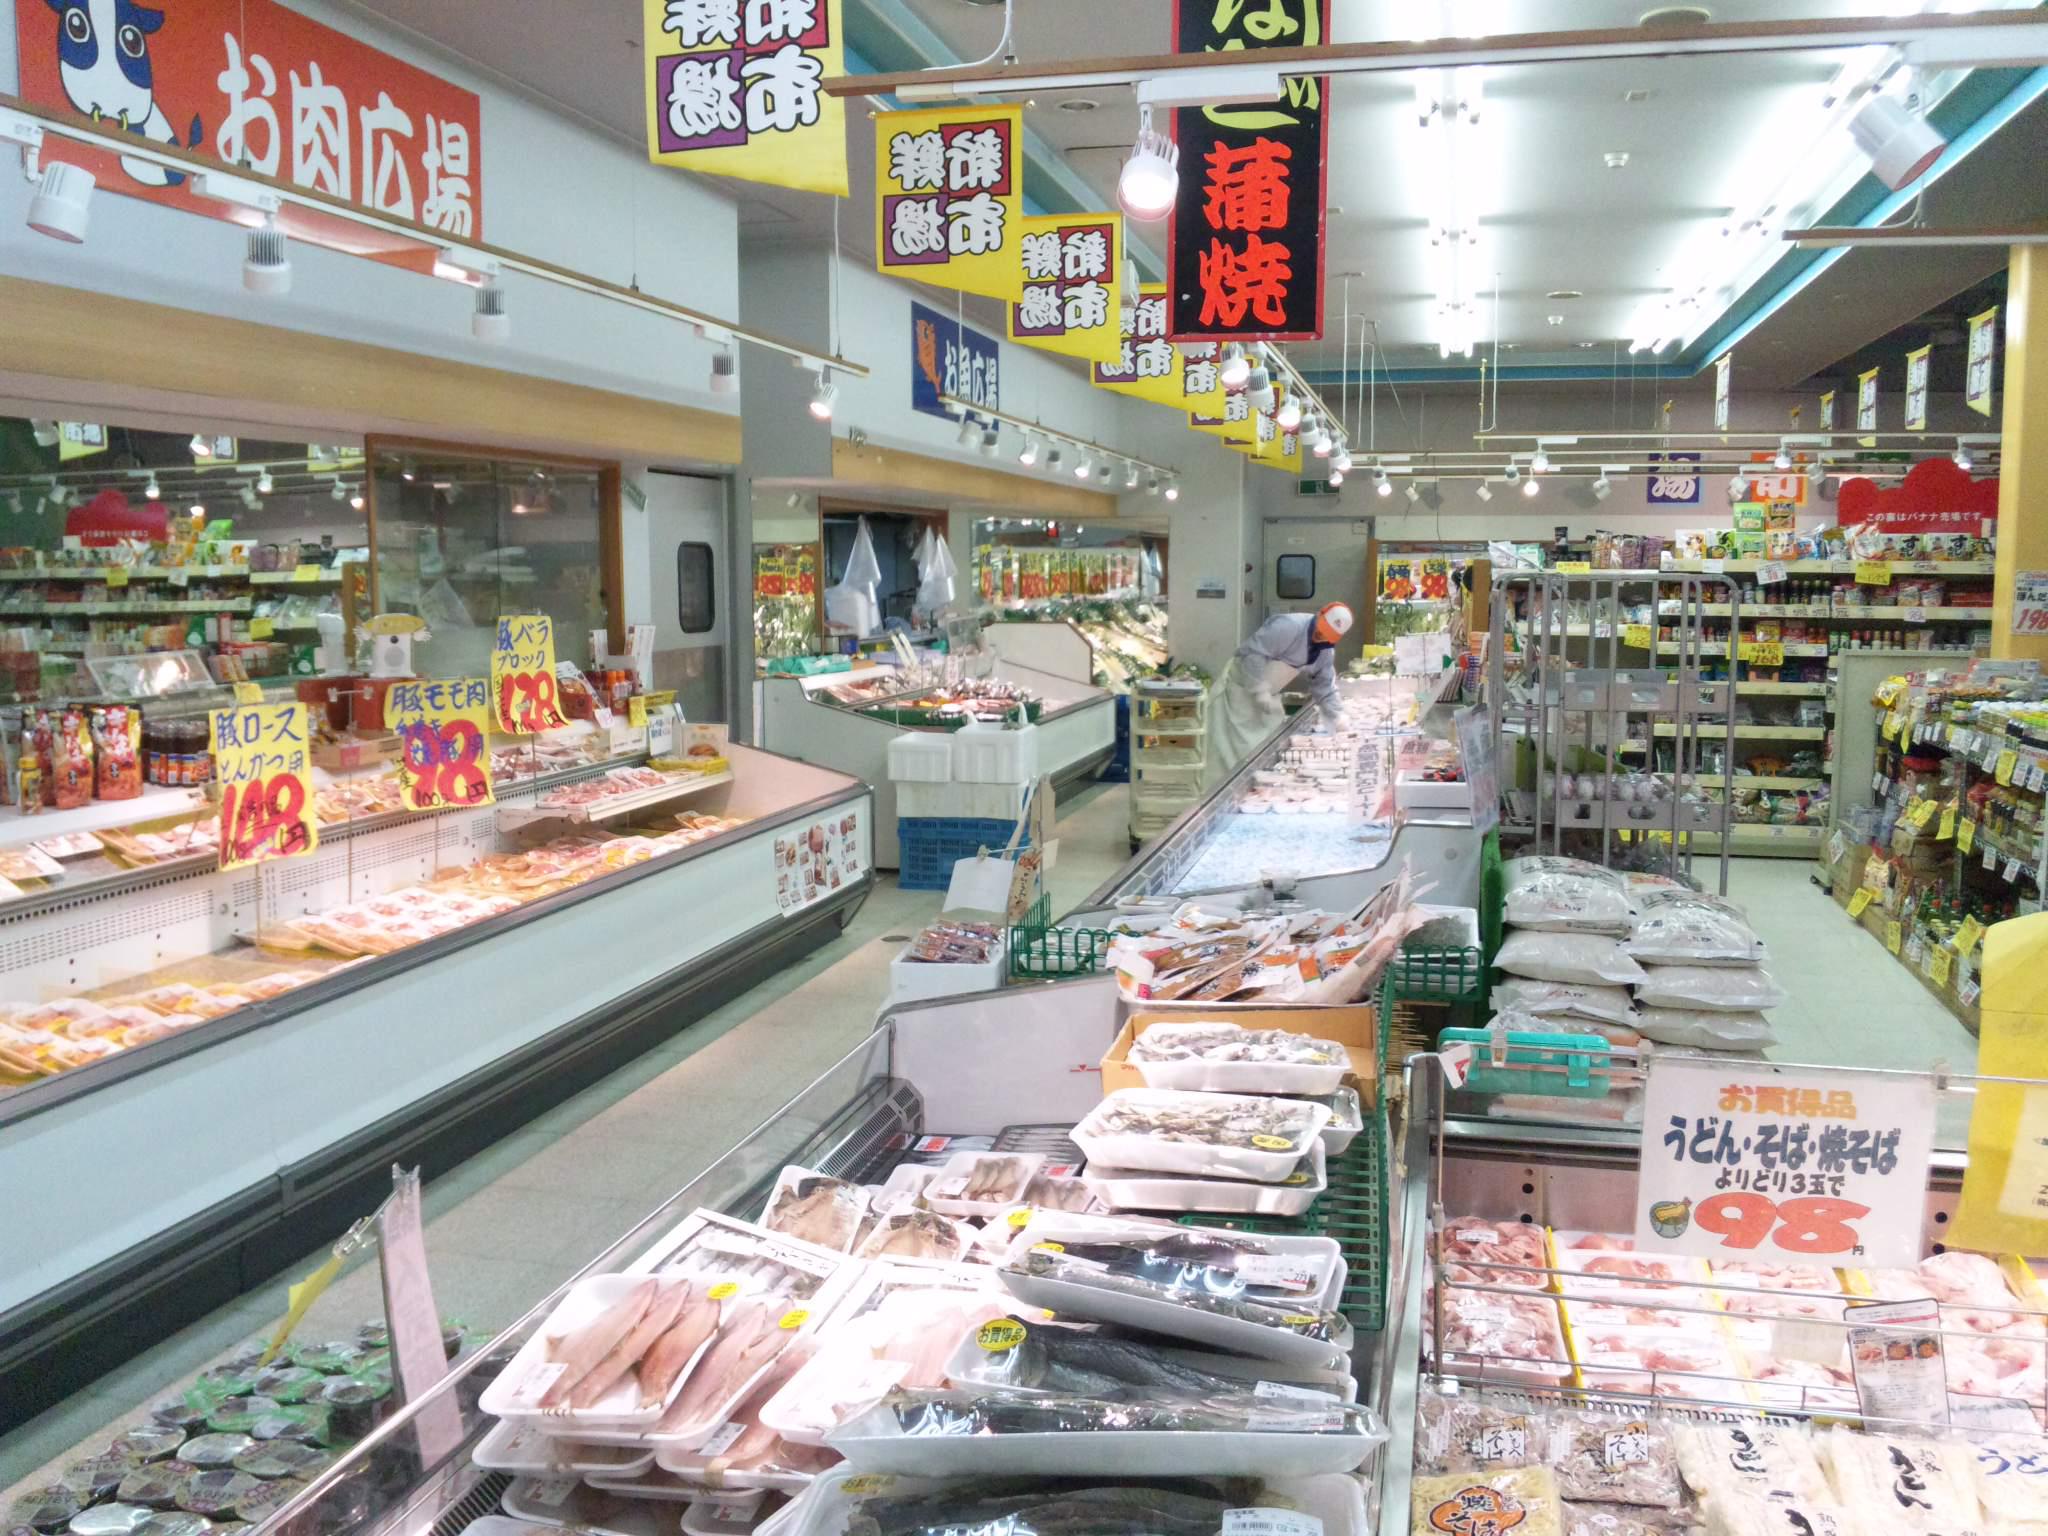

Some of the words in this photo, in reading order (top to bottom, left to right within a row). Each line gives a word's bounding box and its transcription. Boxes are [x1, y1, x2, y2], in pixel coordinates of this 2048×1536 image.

[216, 32, 472, 238] お肉広場
[1199, 136, 1294, 327] 蒲焼
[498, 650, 545, 670] ブロック
[392, 680, 486, 713] 豚モモ肉
[215, 707, 303, 749] 豚ロース
[1717, 1083, 1858, 1120] お買得品
[1663, 1115, 1902, 1175] うどん・そば・焼そば
[1693, 1191, 1872, 1254] 98
[979, 1325, 1024, 1344] お買得品
